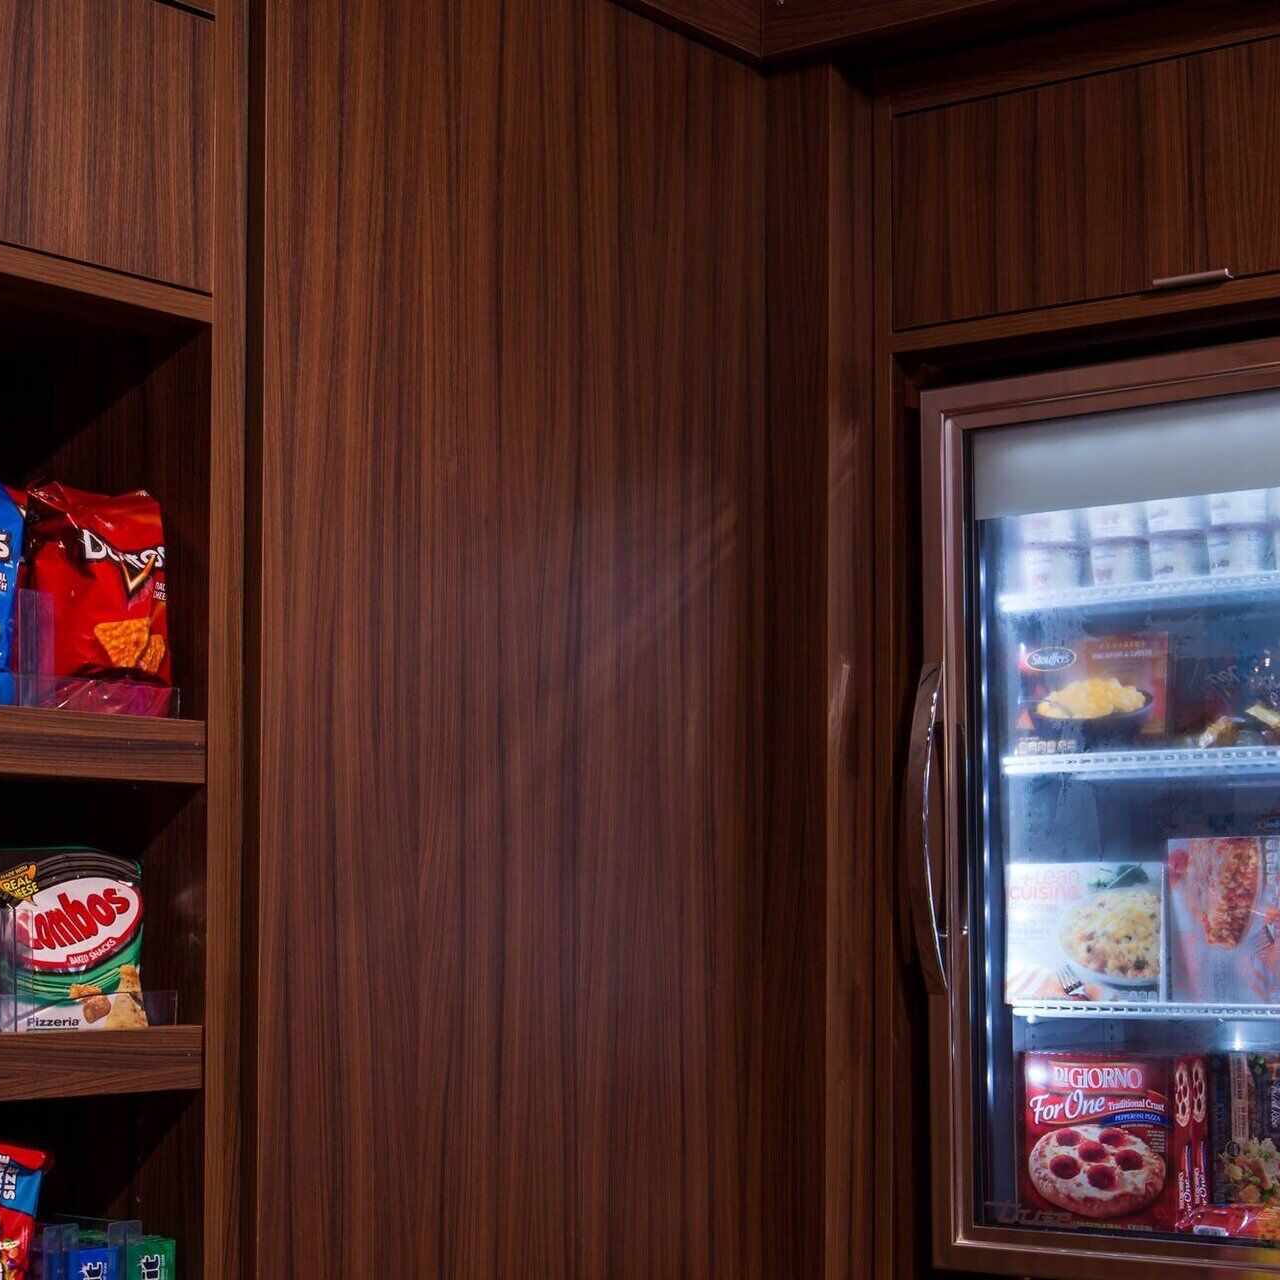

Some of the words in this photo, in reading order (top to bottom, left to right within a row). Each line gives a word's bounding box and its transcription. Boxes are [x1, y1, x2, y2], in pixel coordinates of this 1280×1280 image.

[1029, 650, 1072, 668] Stouffer's
[3, 875, 33, 892] REAL
[1034, 870, 1081, 885] Lean
[1009, 885, 1081, 900] cuisine
[70, 953, 90, 965] BAKED
[90, 938, 116, 957] SNACKS
[26, 1016, 79, 1028] Pizzeria
[1030, 1094, 1065, 1125] For
[1064, 1088, 1106, 1121] One
[1107, 1098, 1147, 1112] Traditional
[1148, 1099, 1166, 1113] Crust
[1114, 1113, 1141, 1123] PEPPERONI
[1141, 1114, 1162, 1123] PIZZA
[4, 1166, 19, 1201] SIZE
